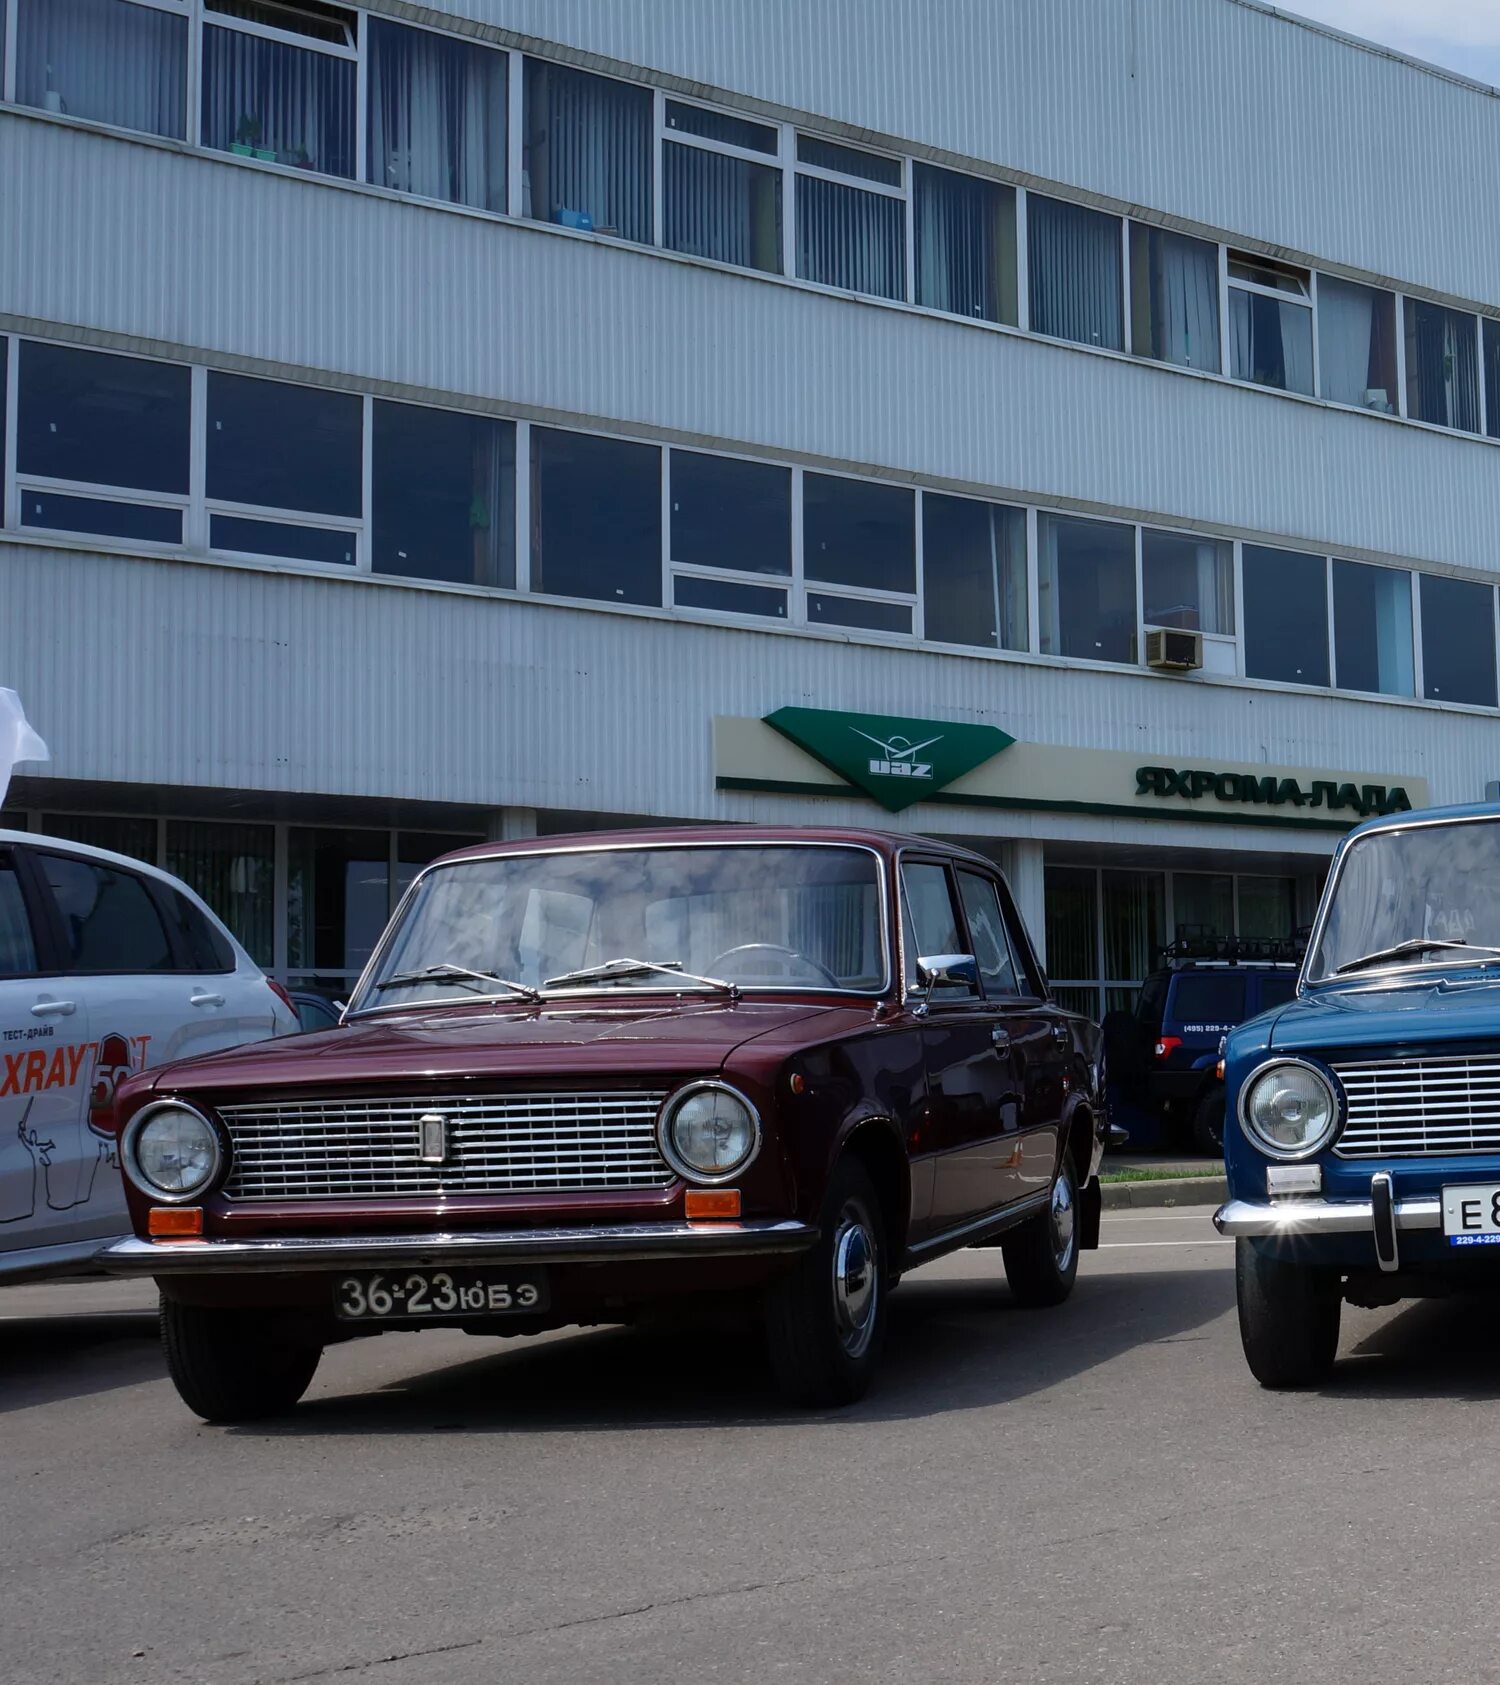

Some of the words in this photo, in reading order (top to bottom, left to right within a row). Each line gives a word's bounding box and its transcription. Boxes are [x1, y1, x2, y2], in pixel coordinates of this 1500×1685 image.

[1135, 766, 1413, 817] ЯХРОМА-ЛАДА
[2, 1024, 54, 1041] ТЕСТ-ДРАЙВ
[0, 1043, 88, 1097] XRAY
